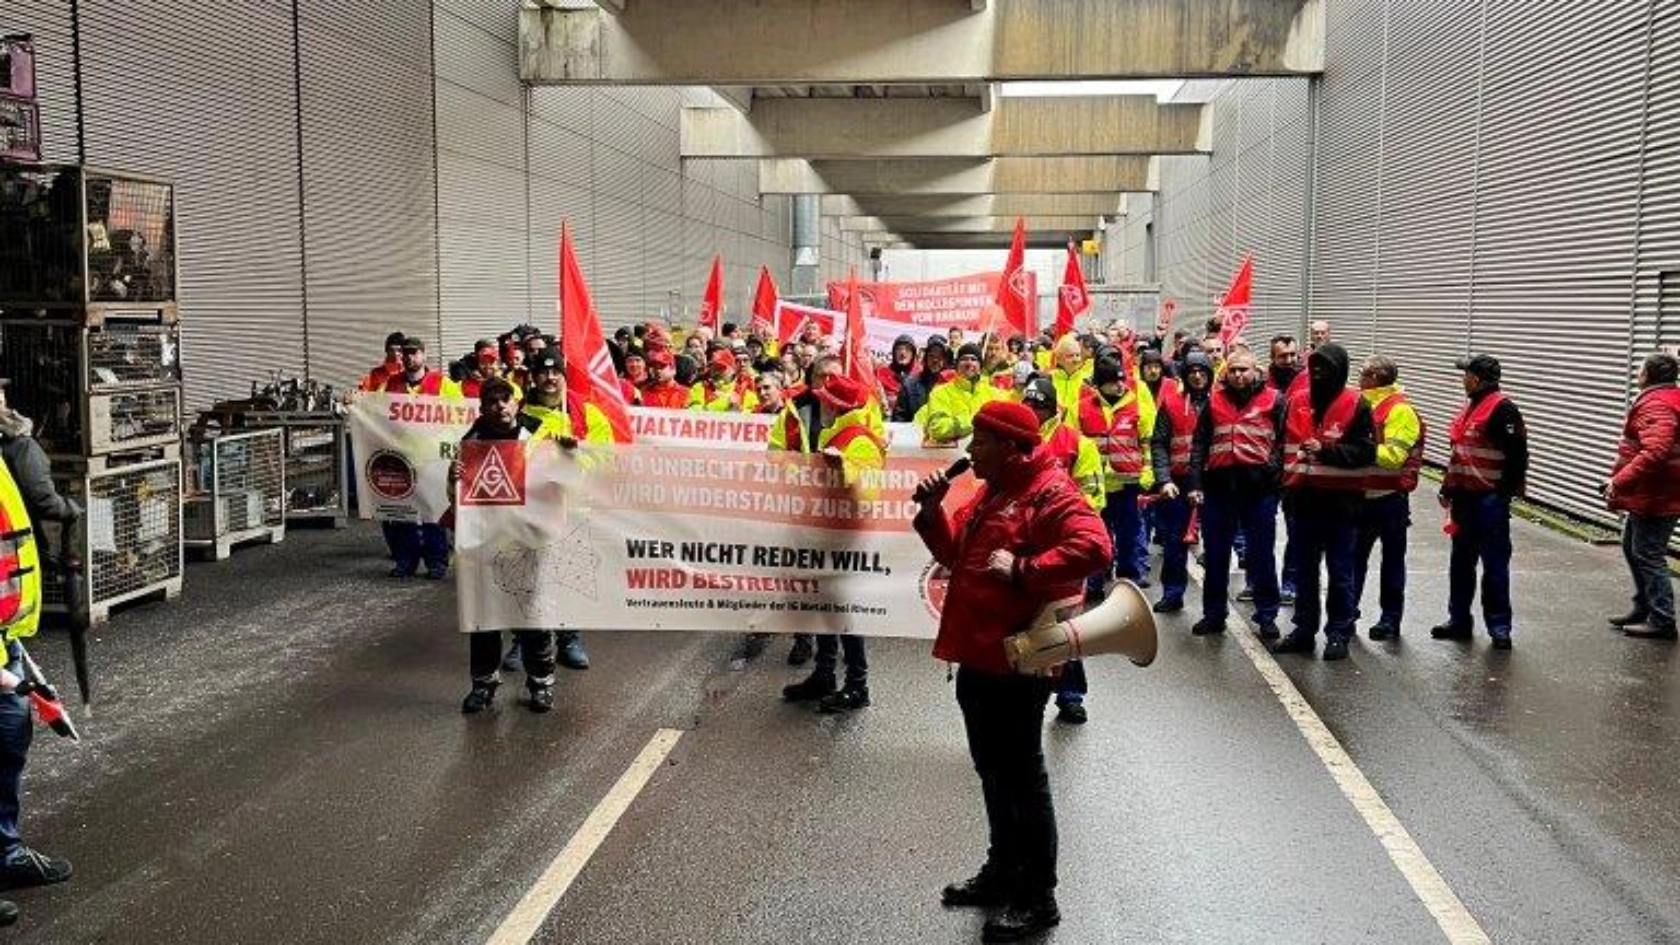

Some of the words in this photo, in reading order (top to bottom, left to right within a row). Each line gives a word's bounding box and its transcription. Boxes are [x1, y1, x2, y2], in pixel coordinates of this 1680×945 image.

[389, 402, 476, 424] SOZIALTA
[629, 415, 774, 442] ZIALTARIFVER
[439, 441, 459, 459] R
[652, 458, 747, 481] UNRECHT
[754, 461, 779, 483] ZU
[861, 469, 917, 489] WIRD
[613, 480, 666, 504] WIRD
[674, 486, 805, 515] WIDERSTAND
[811, 498, 852, 519] ZUR
[858, 500, 917, 520] PFLIC
[626, 539, 674, 559] WER
[681, 542, 748, 565] NICHT
[753, 546, 825, 569] REDEN
[831, 551, 891, 575] WILL,
[626, 568, 687, 589] WIRD
[692, 572, 820, 593] BESTREIKT!
[625, 598, 705, 609] Vertrauensleute
[707, 599, 714, 609] &
[717, 599, 766, 611] Mitglieder
[769, 600, 785, 611] der
[787, 601, 799, 611] IG
[800, 602, 832, 613] Metall
[833, 603, 849, 613] bei
[851, 604, 887, 615] Rhenus
